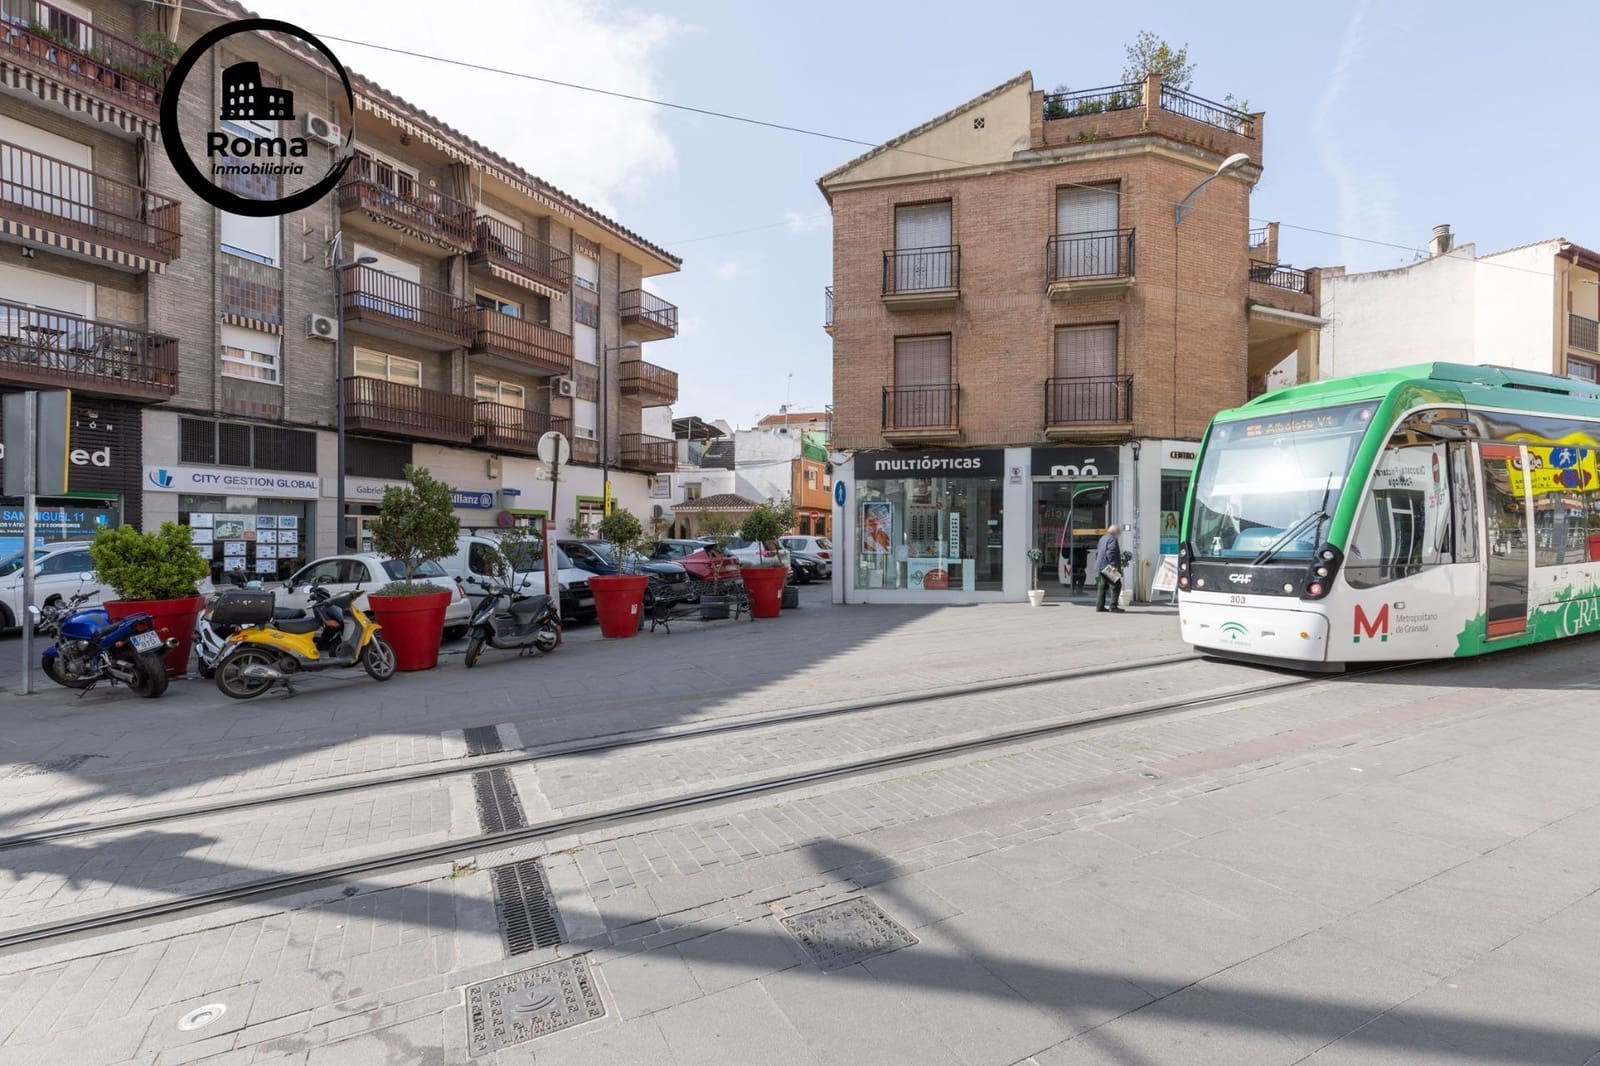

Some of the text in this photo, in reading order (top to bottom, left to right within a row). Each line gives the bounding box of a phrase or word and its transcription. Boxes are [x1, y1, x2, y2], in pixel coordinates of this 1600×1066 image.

[192, 473, 220, 483] CITY
[223, 475, 274, 487] GESTION
[276, 479, 318, 489] GLOBAL
[1230, 595, 1246, 604] 303
[1353, 603, 1389, 641] M
[1396, 613, 1438, 623] Metropolitano
[1396, 624, 1429, 633] de Granada
